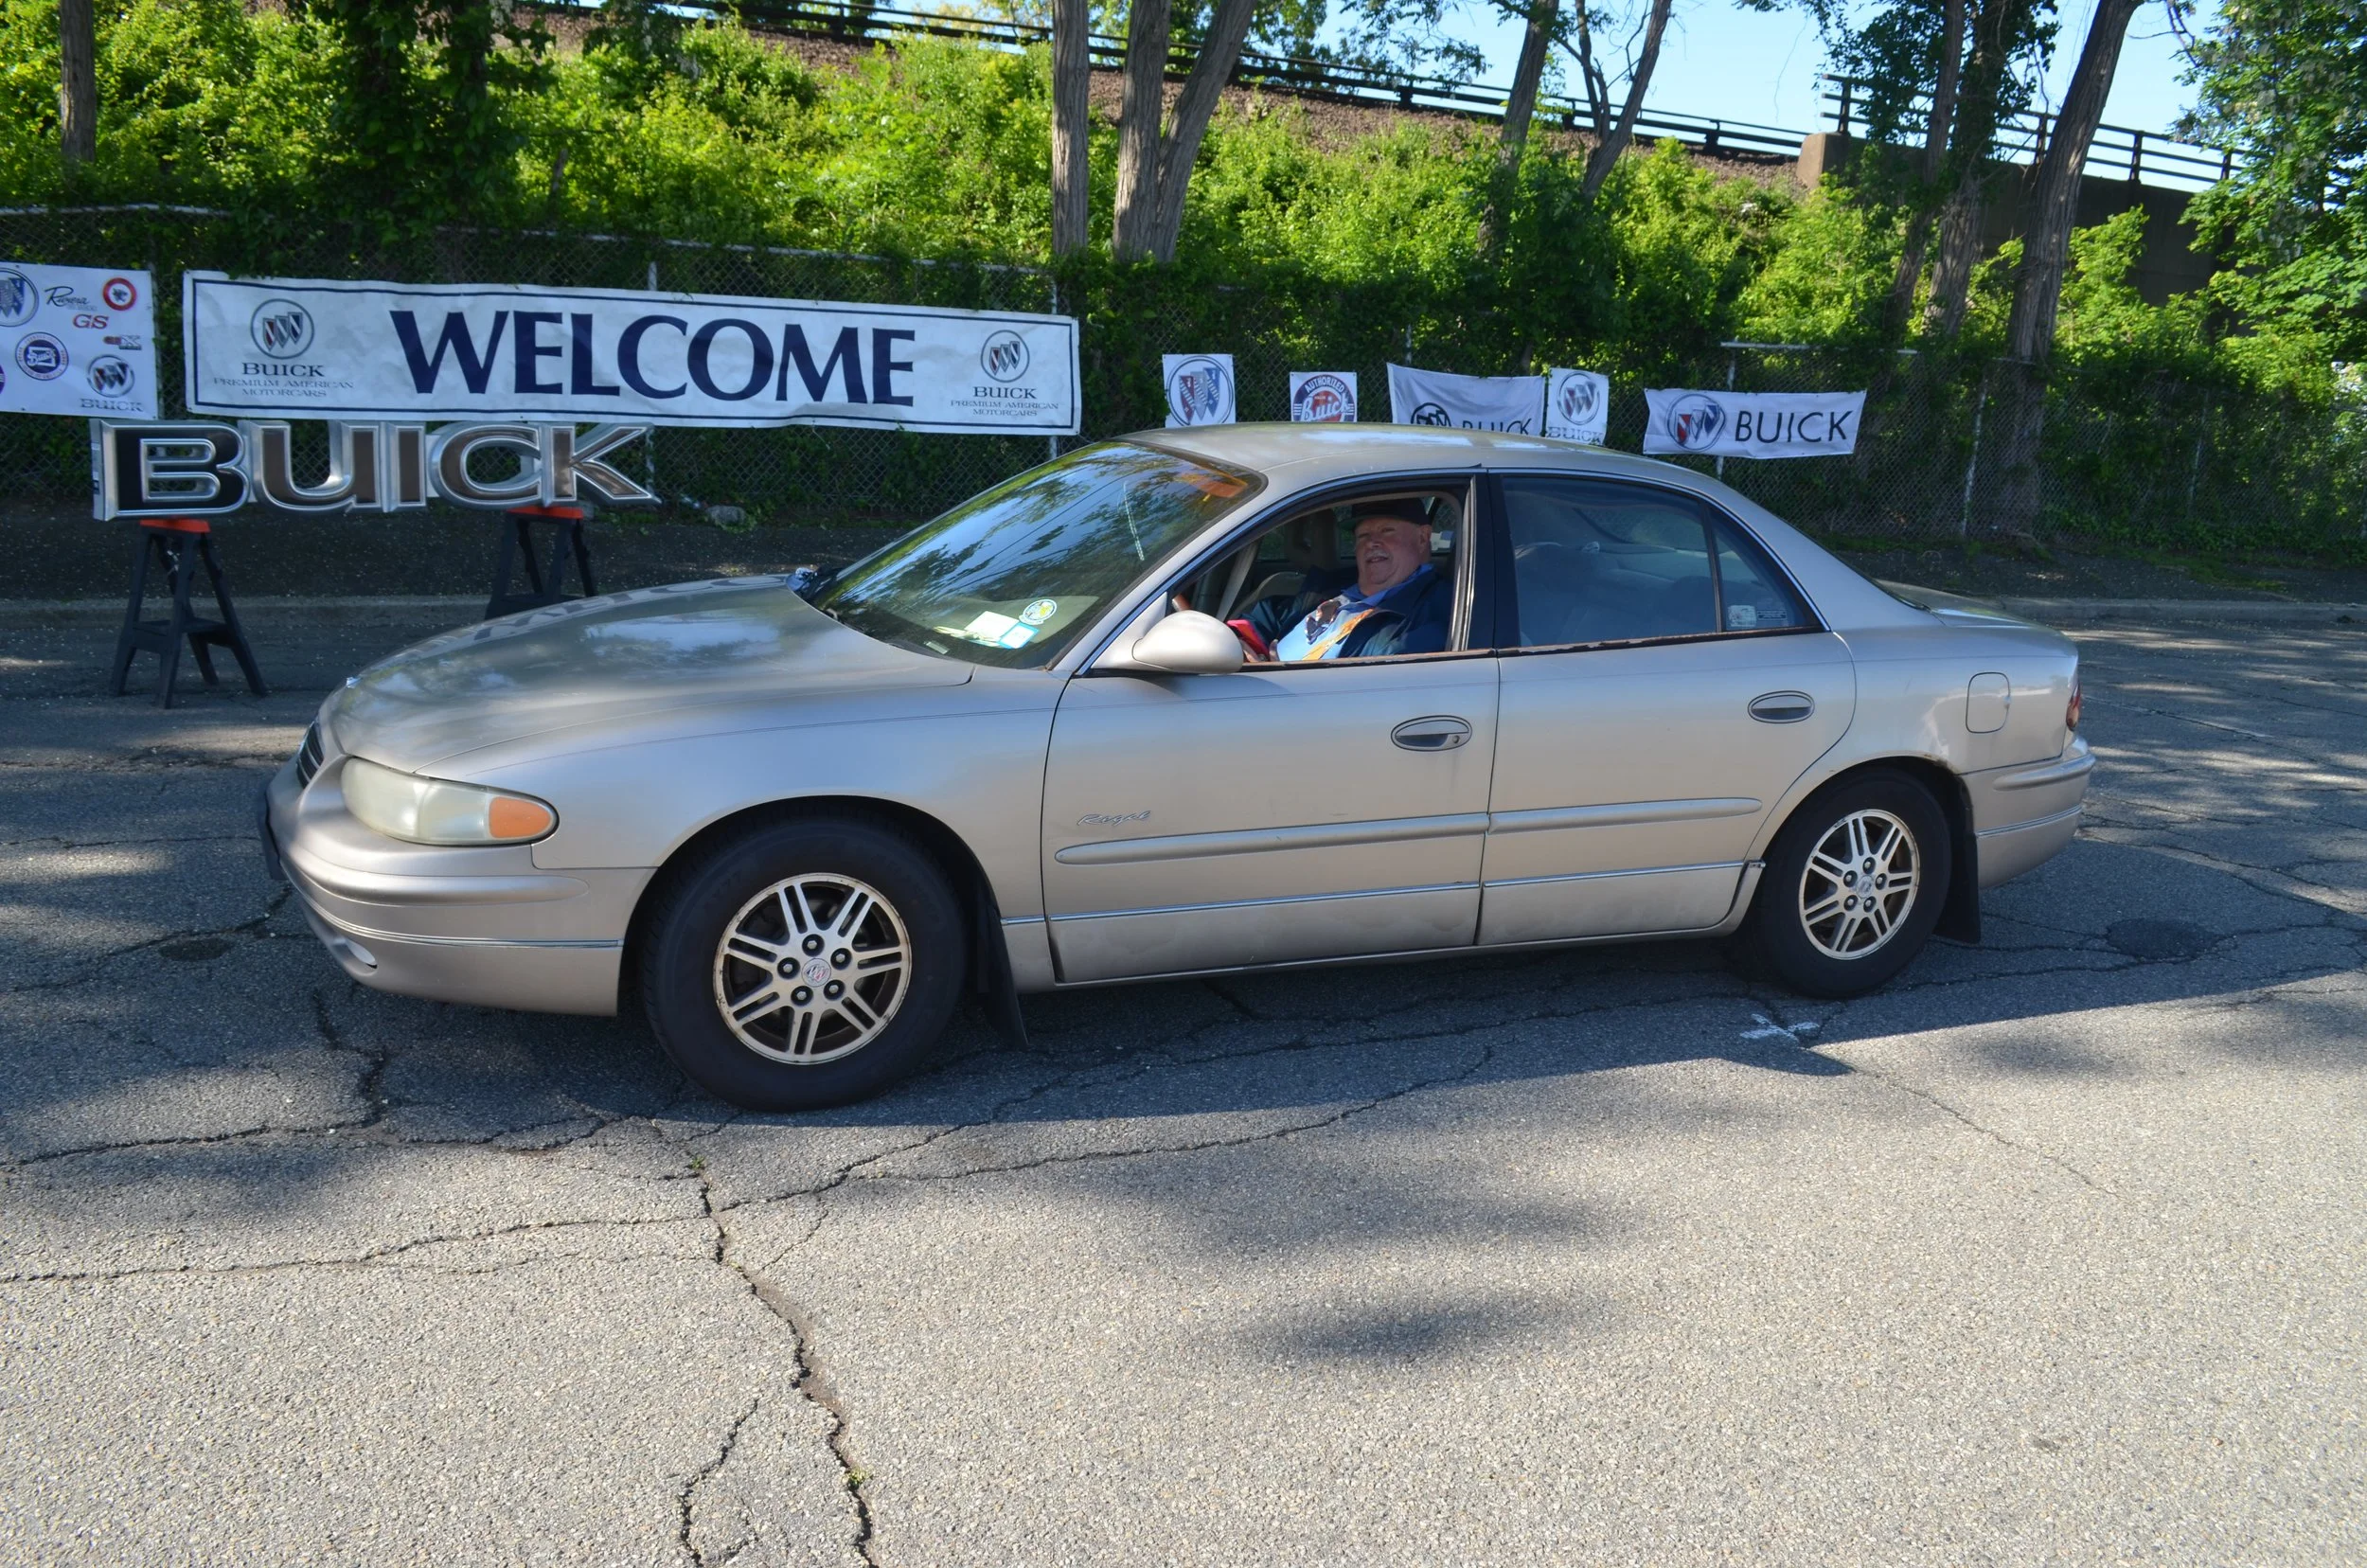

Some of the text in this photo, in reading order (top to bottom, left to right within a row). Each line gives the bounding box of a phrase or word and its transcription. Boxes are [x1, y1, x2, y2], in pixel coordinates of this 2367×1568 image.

[73, 313, 109, 330] GS
[389, 311, 915, 407] WELCOME
[241, 362, 326, 378] BUICK
[213, 377, 354, 389] PREMIUM AMERICAN
[1304, 376, 1345, 394] AUTHORIZED
[241, 388, 328, 398] MOTORCARS
[973, 386, 1038, 400] BUICK
[80, 398, 144, 413] BUICK
[950, 399, 1059, 410] PREMIUM AMERICAN
[972, 408, 1038, 417] MOTORCARS
[1300, 392, 1349, 422] Buick
[1735, 411, 1853, 442] BUICK
[90, 417, 660, 522] BUICK
